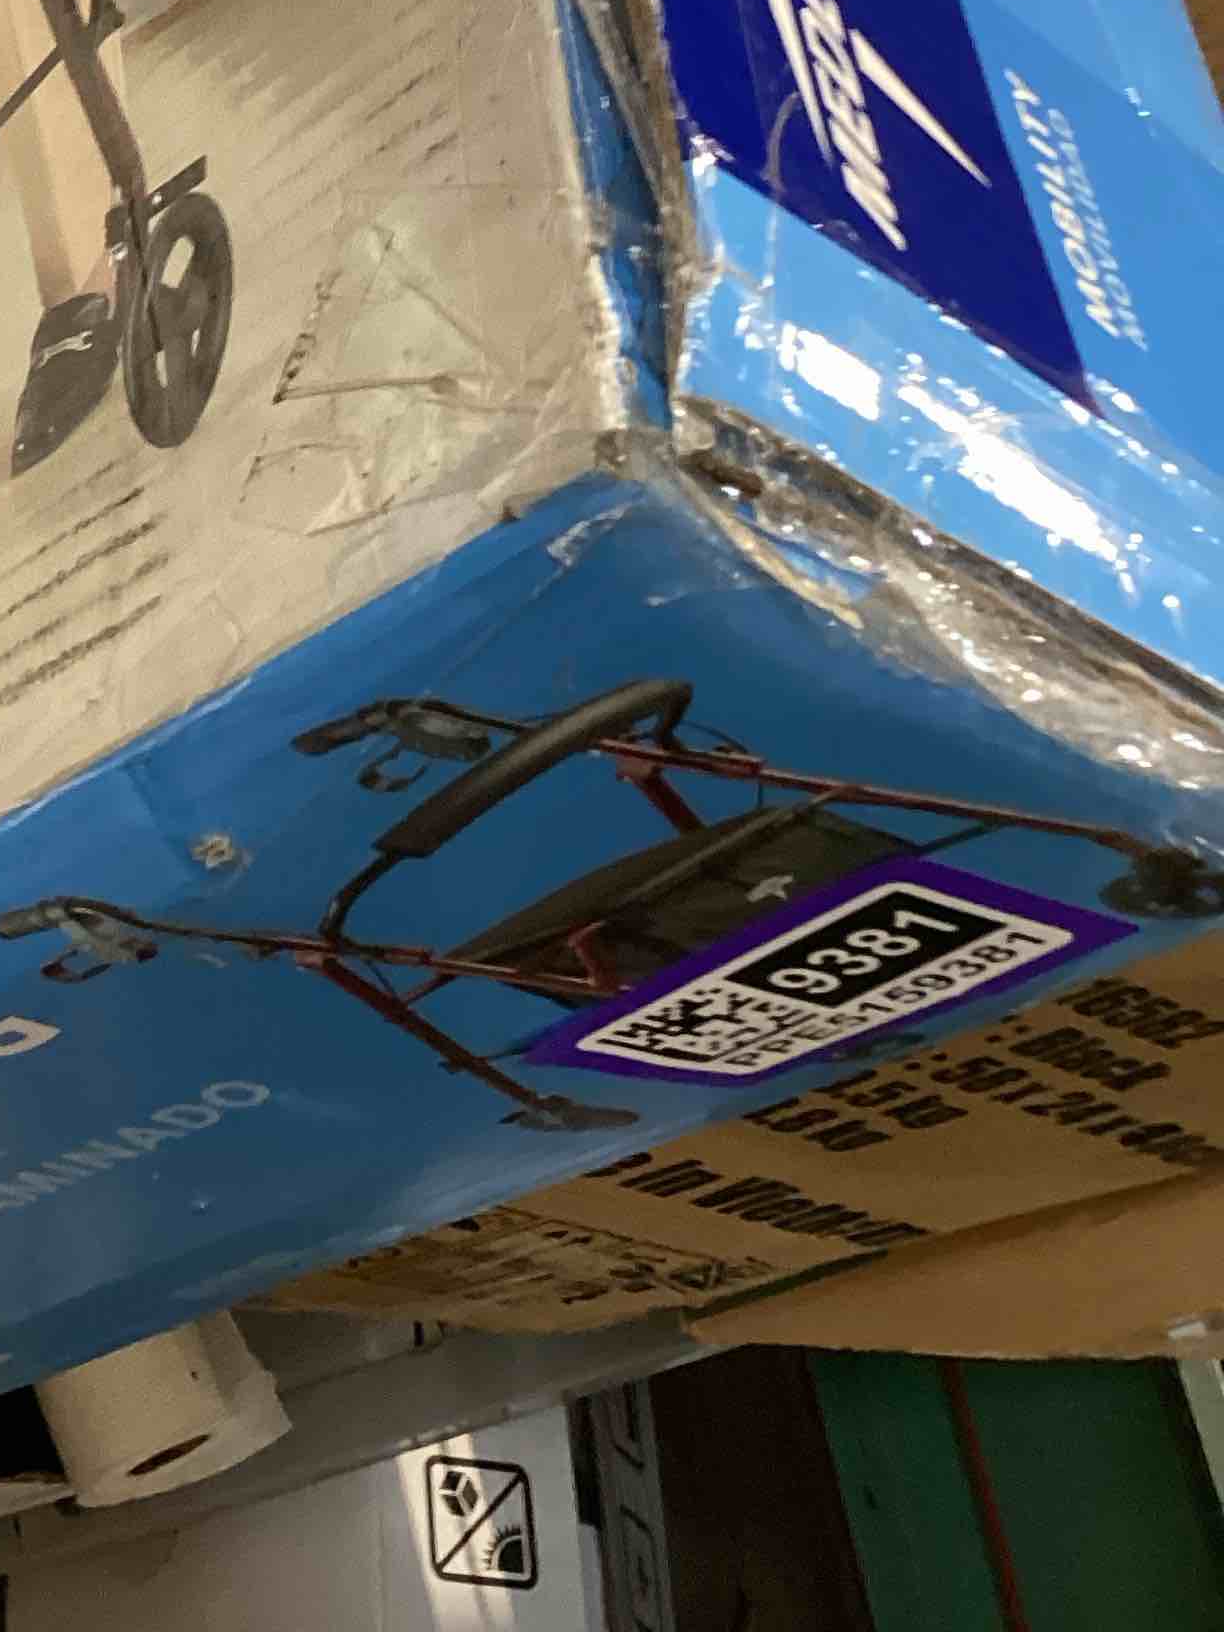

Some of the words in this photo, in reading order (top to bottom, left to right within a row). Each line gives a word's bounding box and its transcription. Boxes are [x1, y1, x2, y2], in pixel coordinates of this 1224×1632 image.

[1003, 67, 1121, 338] MOBILITY
[724, 927, 1047, 1067] PPE5159381
[767, 908, 962, 996] 9381
